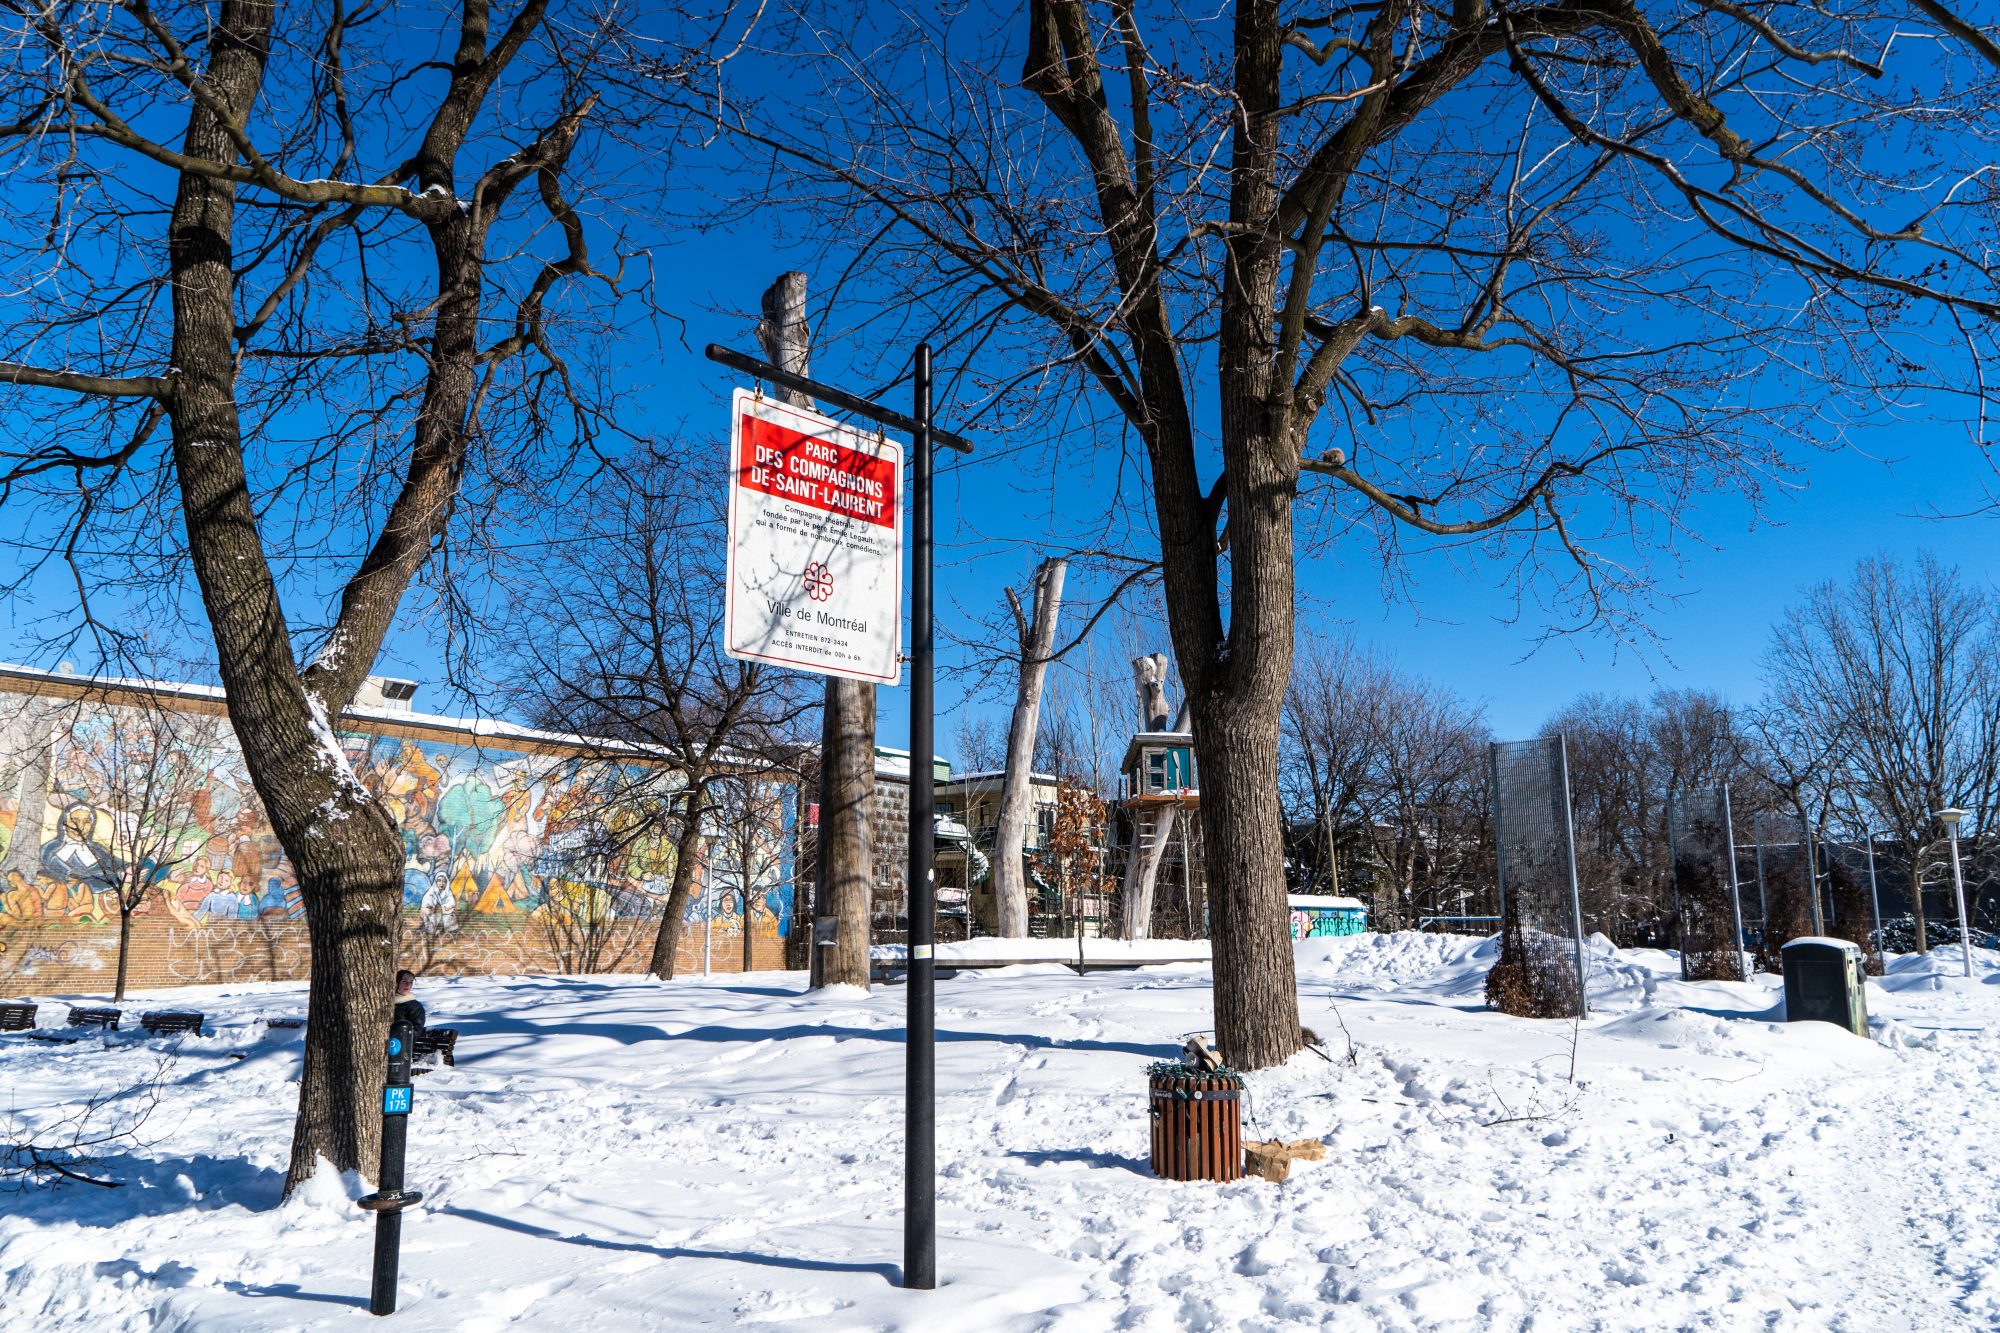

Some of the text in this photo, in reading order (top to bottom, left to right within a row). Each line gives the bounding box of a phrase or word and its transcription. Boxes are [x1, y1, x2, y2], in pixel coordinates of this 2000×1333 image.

[805, 441, 838, 464] PARC
[755, 444, 883, 499] DES COMPAGNONS
[751, 465, 884, 519] DE-SAINT-LAURENT
[763, 508, 787, 521] fondée
[790, 516, 801, 525] par
[803, 518, 810, 527] le
[785, 504, 822, 521] Compagnie
[755, 518, 767, 528] qui
[776, 522, 797, 534] formé
[799, 528, 808, 537] de
[810, 532, 843, 546] nombreux
[767, 600, 867, 633] Ville de Montréal
[785, 629, 818, 641] ENTRETIEN
[795, 643, 823, 654] INTERDIT
[391, 1088, 405, 1099] PK
[389, 1099, 407, 1111] 175
